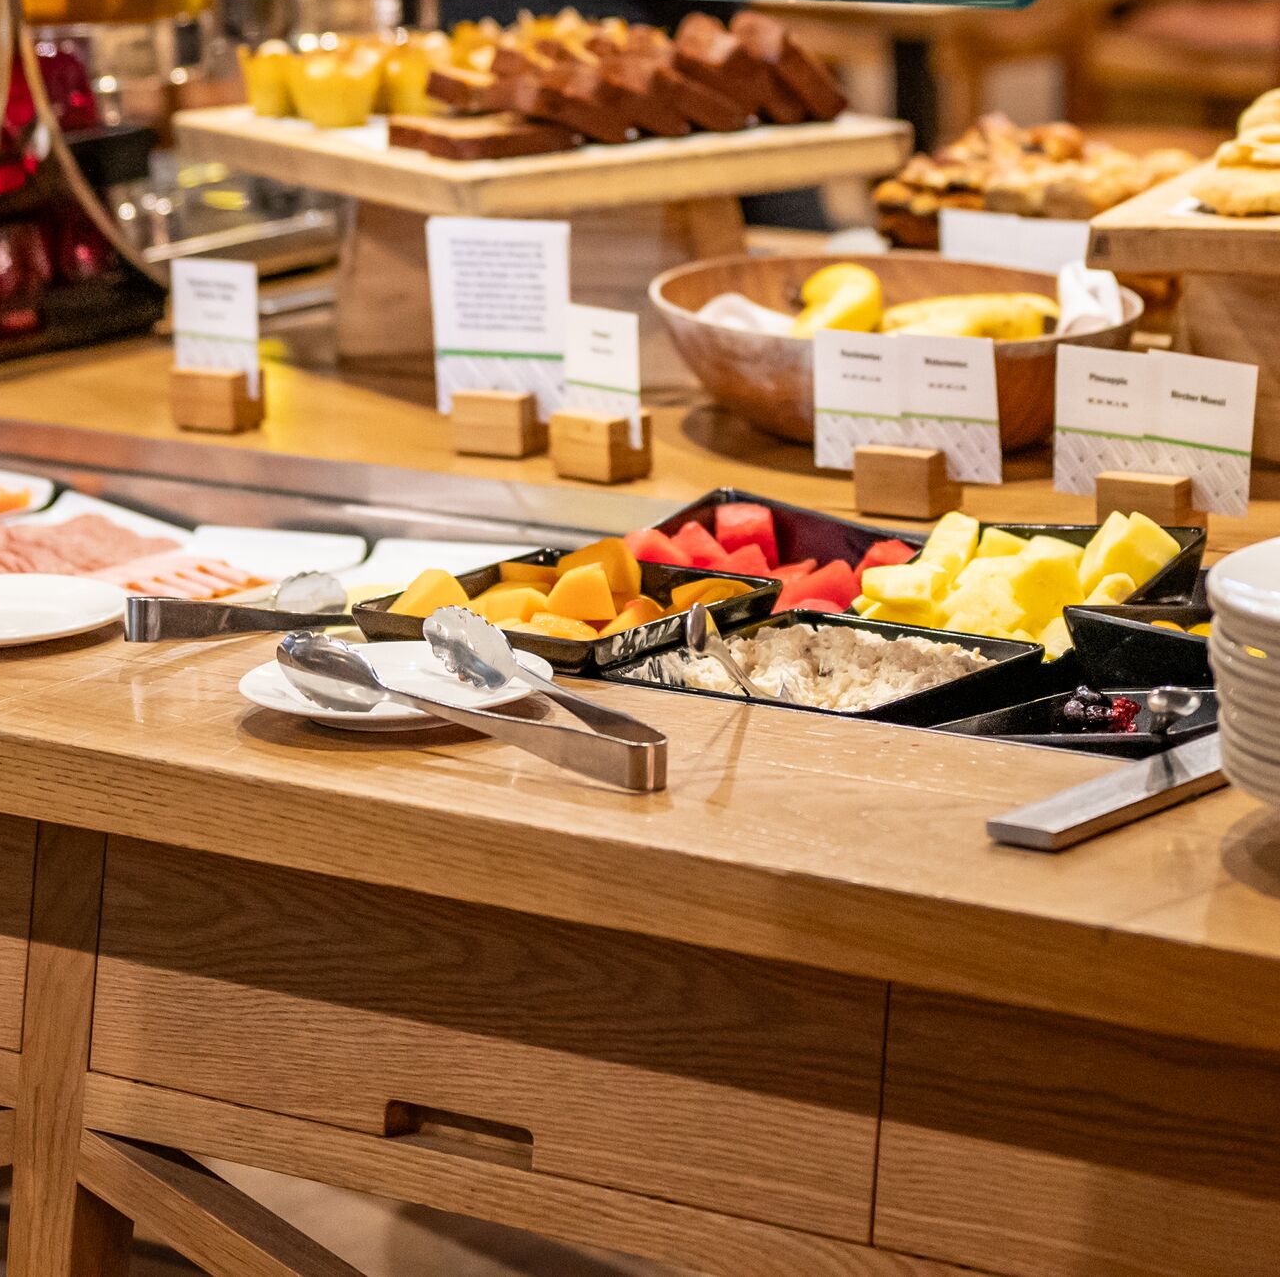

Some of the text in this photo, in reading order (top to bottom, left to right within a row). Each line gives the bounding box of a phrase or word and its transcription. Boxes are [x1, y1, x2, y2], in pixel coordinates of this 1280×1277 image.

[1089, 372, 1128, 386] Pineapple
[1171, 389, 1226, 407] Bircher Muesli
